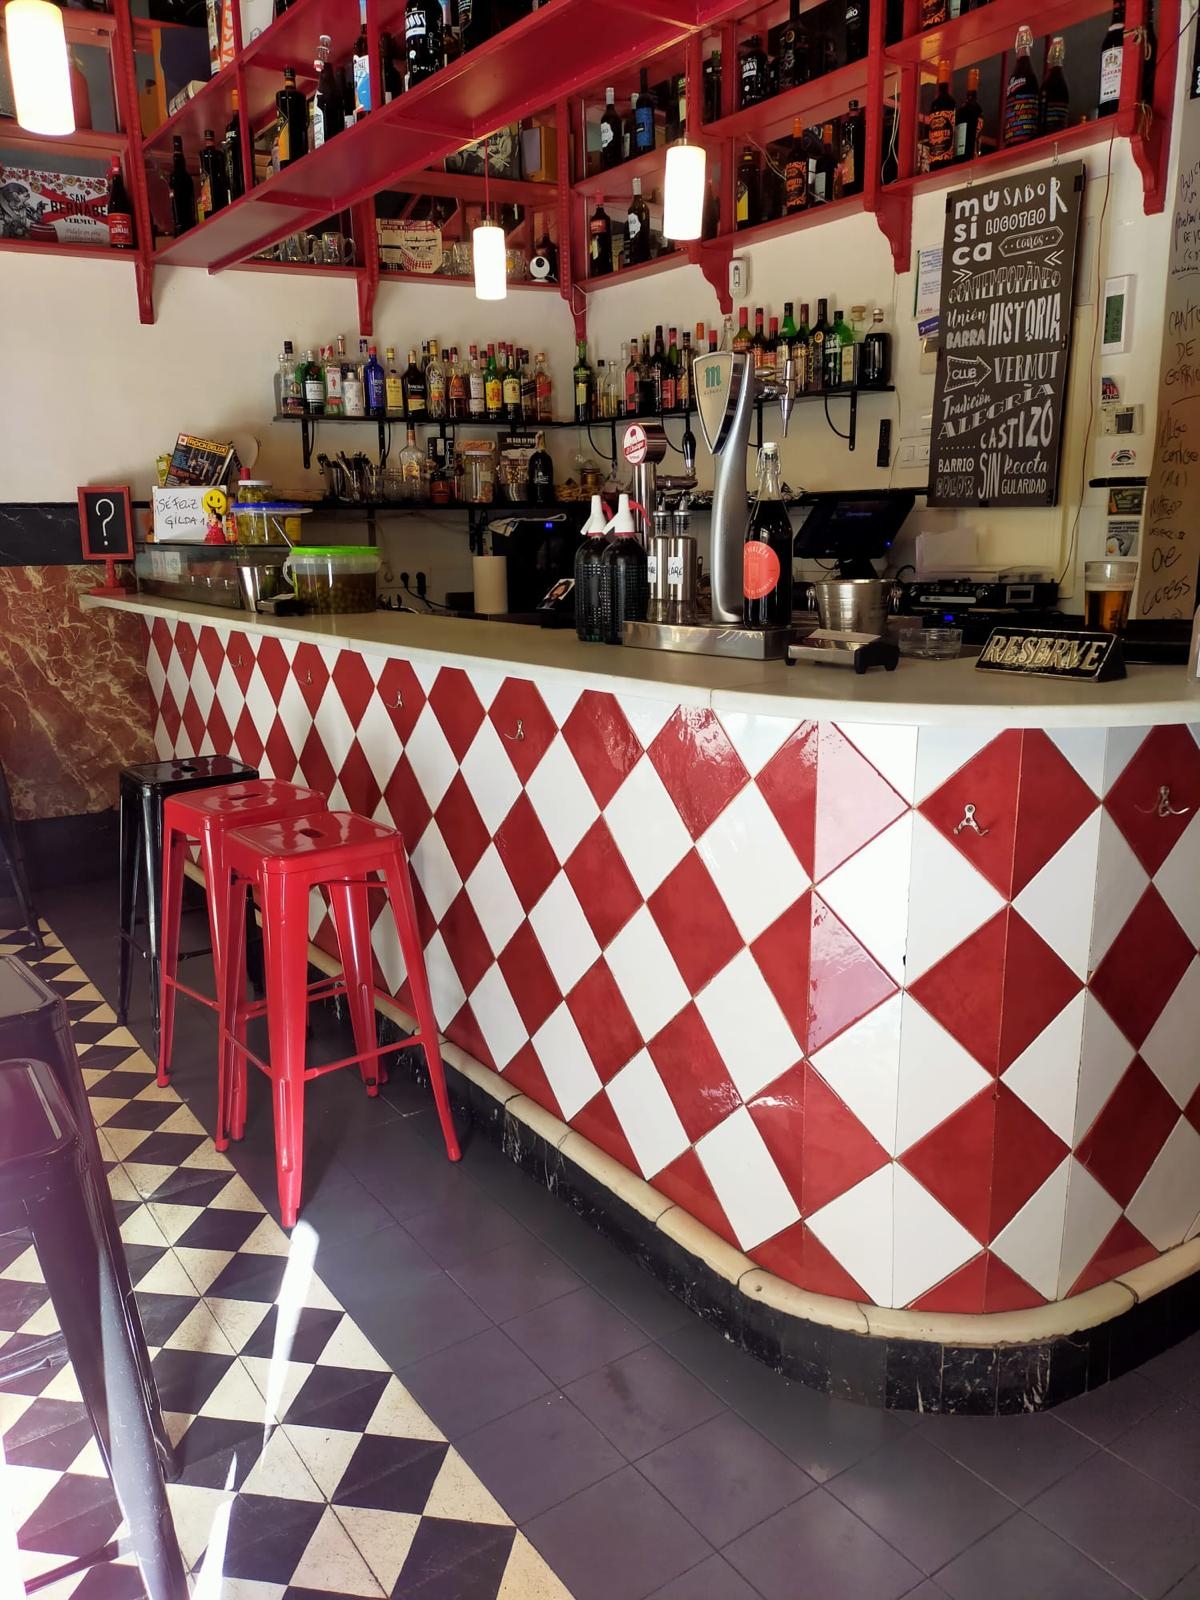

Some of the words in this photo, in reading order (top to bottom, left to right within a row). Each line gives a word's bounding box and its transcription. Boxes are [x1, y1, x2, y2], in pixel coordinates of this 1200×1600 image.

[953, 216, 978, 243] si
[986, 208, 1046, 235] LIGOTEO
[952, 242, 993, 266] ca
[987, 292, 1061, 347] HISTORIA
[946, 328, 986, 349] BARRA
[1176, 339, 1196, 364] DE
[952, 368, 977, 384] CLUB
[993, 350, 1060, 384] VERMUT
[980, 398, 1054, 451] CASTIZO
[938, 458, 975, 473] BARRIO
[977, 452, 1002, 499] SIN
[1003, 451, 1048, 475] Receta
[1001, 478, 1047, 496] GULARIDAD
[165, 515, 197, 529] GILDA
[981, 635, 1107, 670] RESERVE
